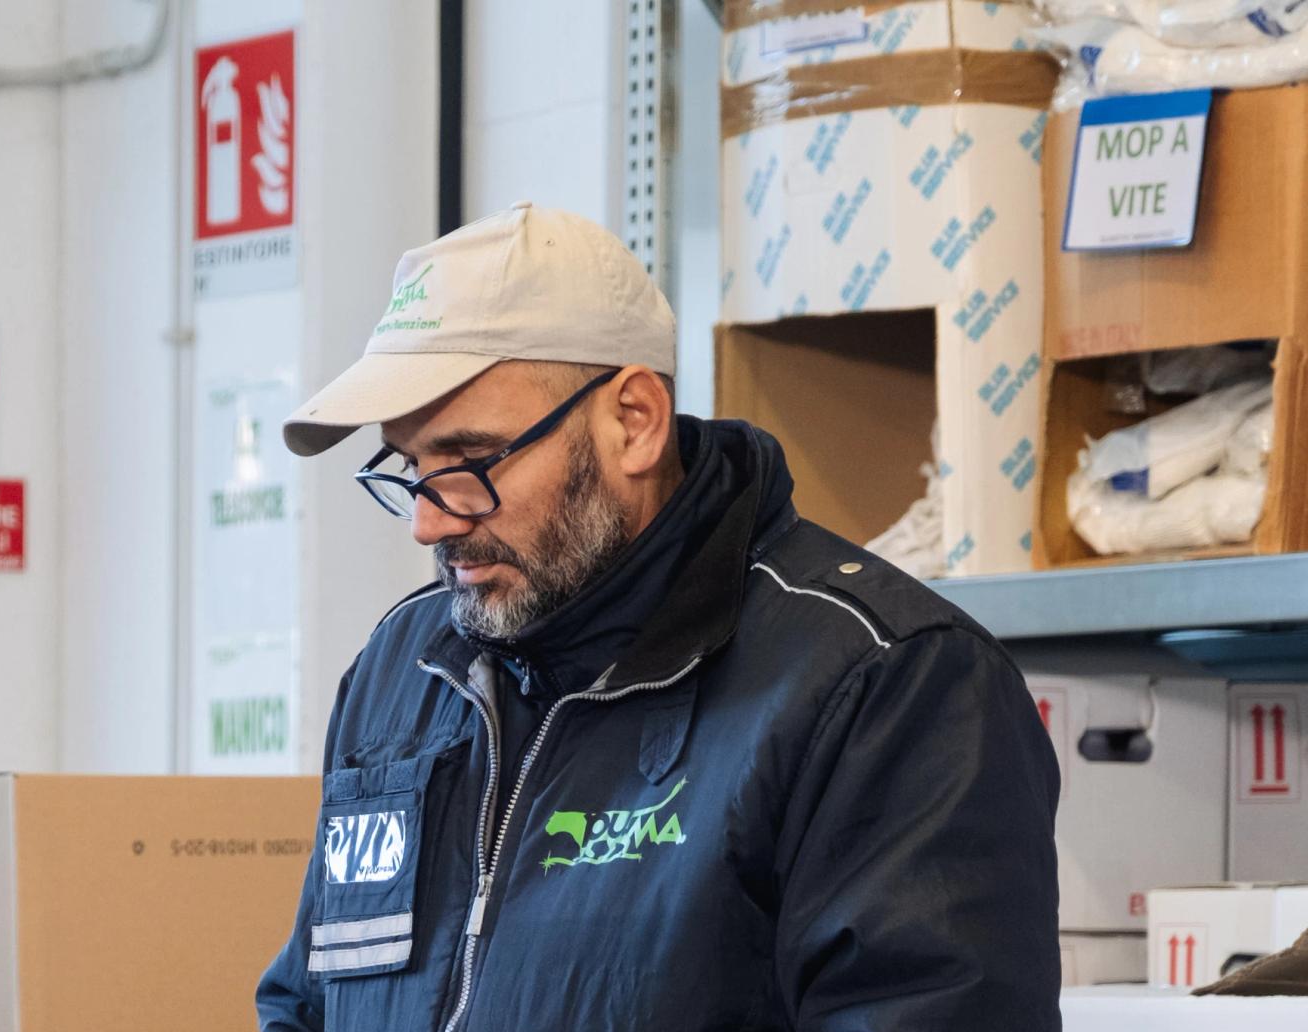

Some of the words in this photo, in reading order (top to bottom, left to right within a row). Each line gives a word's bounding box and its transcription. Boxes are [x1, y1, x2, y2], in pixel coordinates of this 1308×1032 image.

[1096, 125, 1165, 161] MOP
[1171, 121, 1189, 154] A
[1109, 182, 1168, 217] VITE
